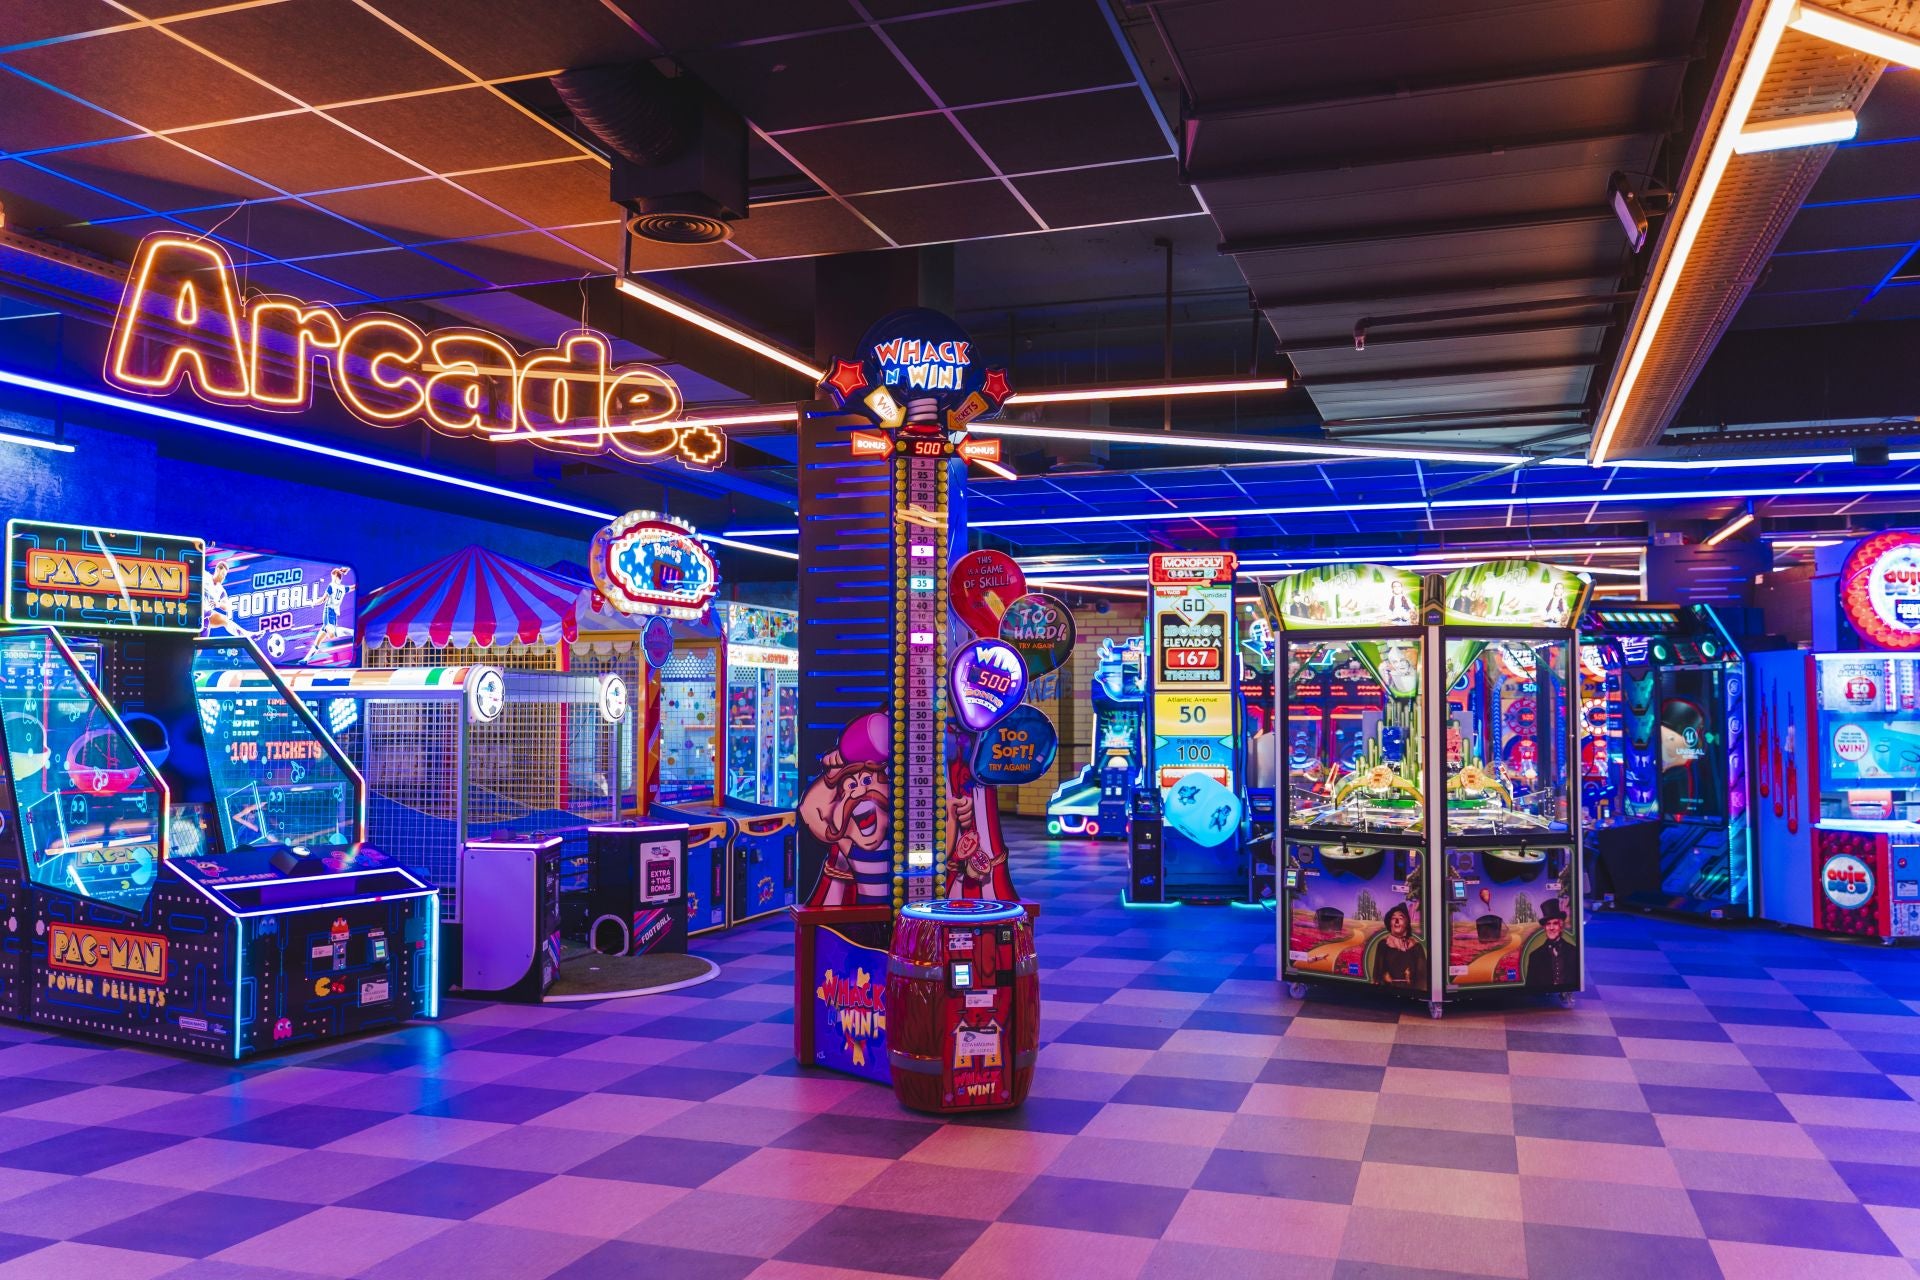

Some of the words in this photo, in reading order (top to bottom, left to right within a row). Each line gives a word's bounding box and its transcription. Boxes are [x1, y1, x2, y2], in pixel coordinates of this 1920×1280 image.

[875, 337, 971, 366] WHACK
[885, 367, 900, 386] N
[908, 363, 963, 390] WIN!
[876, 395, 895, 419] WIN
[954, 401, 979, 423] TICKETS
[857, 440, 887, 450] BONUS
[914, 441, 941, 455] 500
[964, 446, 995, 455] BONUS
[653, 543, 683, 564] BONUS
[977, 555, 992, 564] THIS
[980, 565, 1004, 575] GAME
[1164, 558, 1222, 568] MONOPOLY
[34, 555, 183, 592] PAC-MAN
[254, 568, 302, 589] WORLD
[917, 580, 927, 588] 35
[964, 580, 976, 589] OF
[26, 592, 95, 610] POWER
[106, 597, 188, 616] PELLETS
[227, 582, 320, 620] FOOTBALL
[1183, 599, 1205, 612] GO
[259, 612, 293, 632] PRO
[1019, 608, 1057, 625] TOO
[1014, 624, 1067, 641] HARD!
[1163, 638, 1211, 648] ELEVADO
[1212, 639, 1222, 648] A
[1177, 651, 1209, 666] 167
[978, 670, 1011, 692] 500
[1179, 706, 1207, 723] 50
[230, 741, 258, 761] 100
[265, 740, 322, 760] TICKETS
[1177, 746, 1212, 761] 100
[1838, 744, 1865, 752] WIN!
[988, 763, 1003, 771] TRY
[1004, 763, 1031, 771] AGAIN!
[650, 869, 671, 878] EXTRA
[650, 884, 671, 893] BONUS
[640, 913, 672, 944] FOOTBALL
[53, 929, 163, 976] PAC-MAN
[48, 972, 94, 996] POWER
[102, 979, 167, 1008] PELLETS
[822, 974, 886, 1012] WHACK
[840, 1009, 880, 1039] WIN!
[967, 1081, 996, 1097] WIN!
